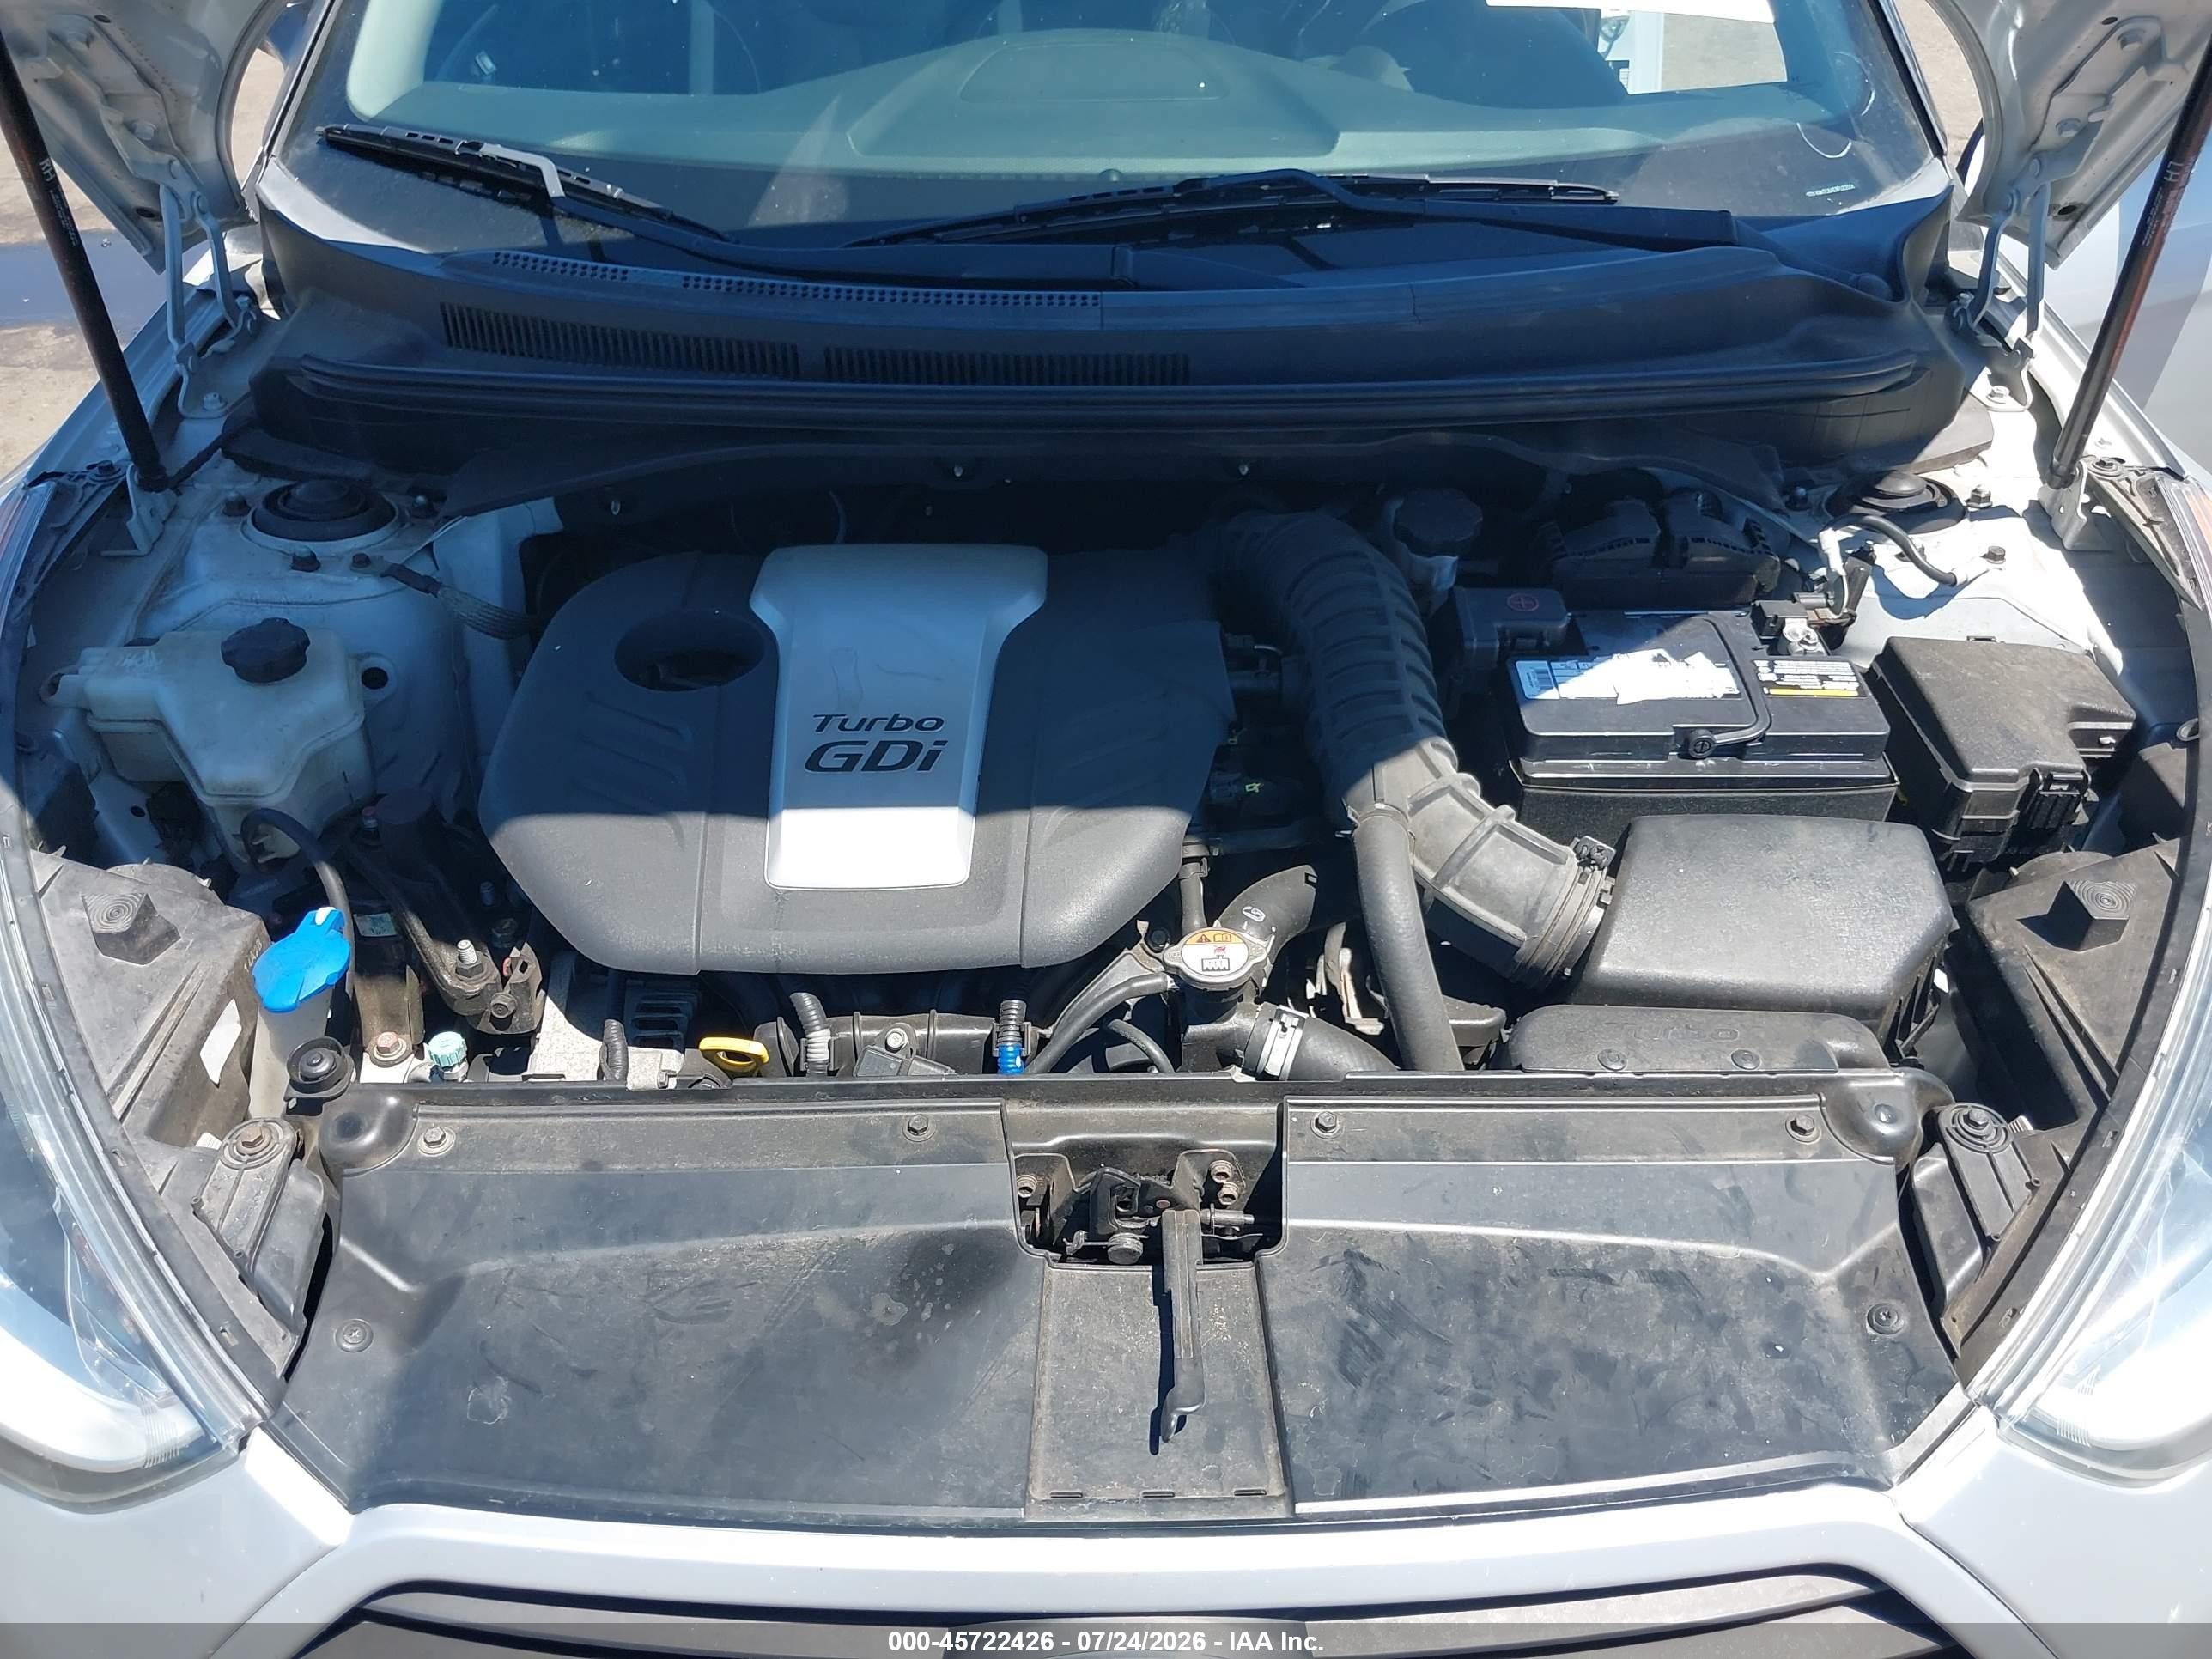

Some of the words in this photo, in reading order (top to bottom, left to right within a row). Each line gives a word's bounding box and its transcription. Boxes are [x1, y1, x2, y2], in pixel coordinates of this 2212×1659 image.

[40, 158, 56, 182] RH
[2163, 161, 2185, 182] LH
[813, 714, 945, 732] Turbo
[805, 740, 949, 773] GDi
